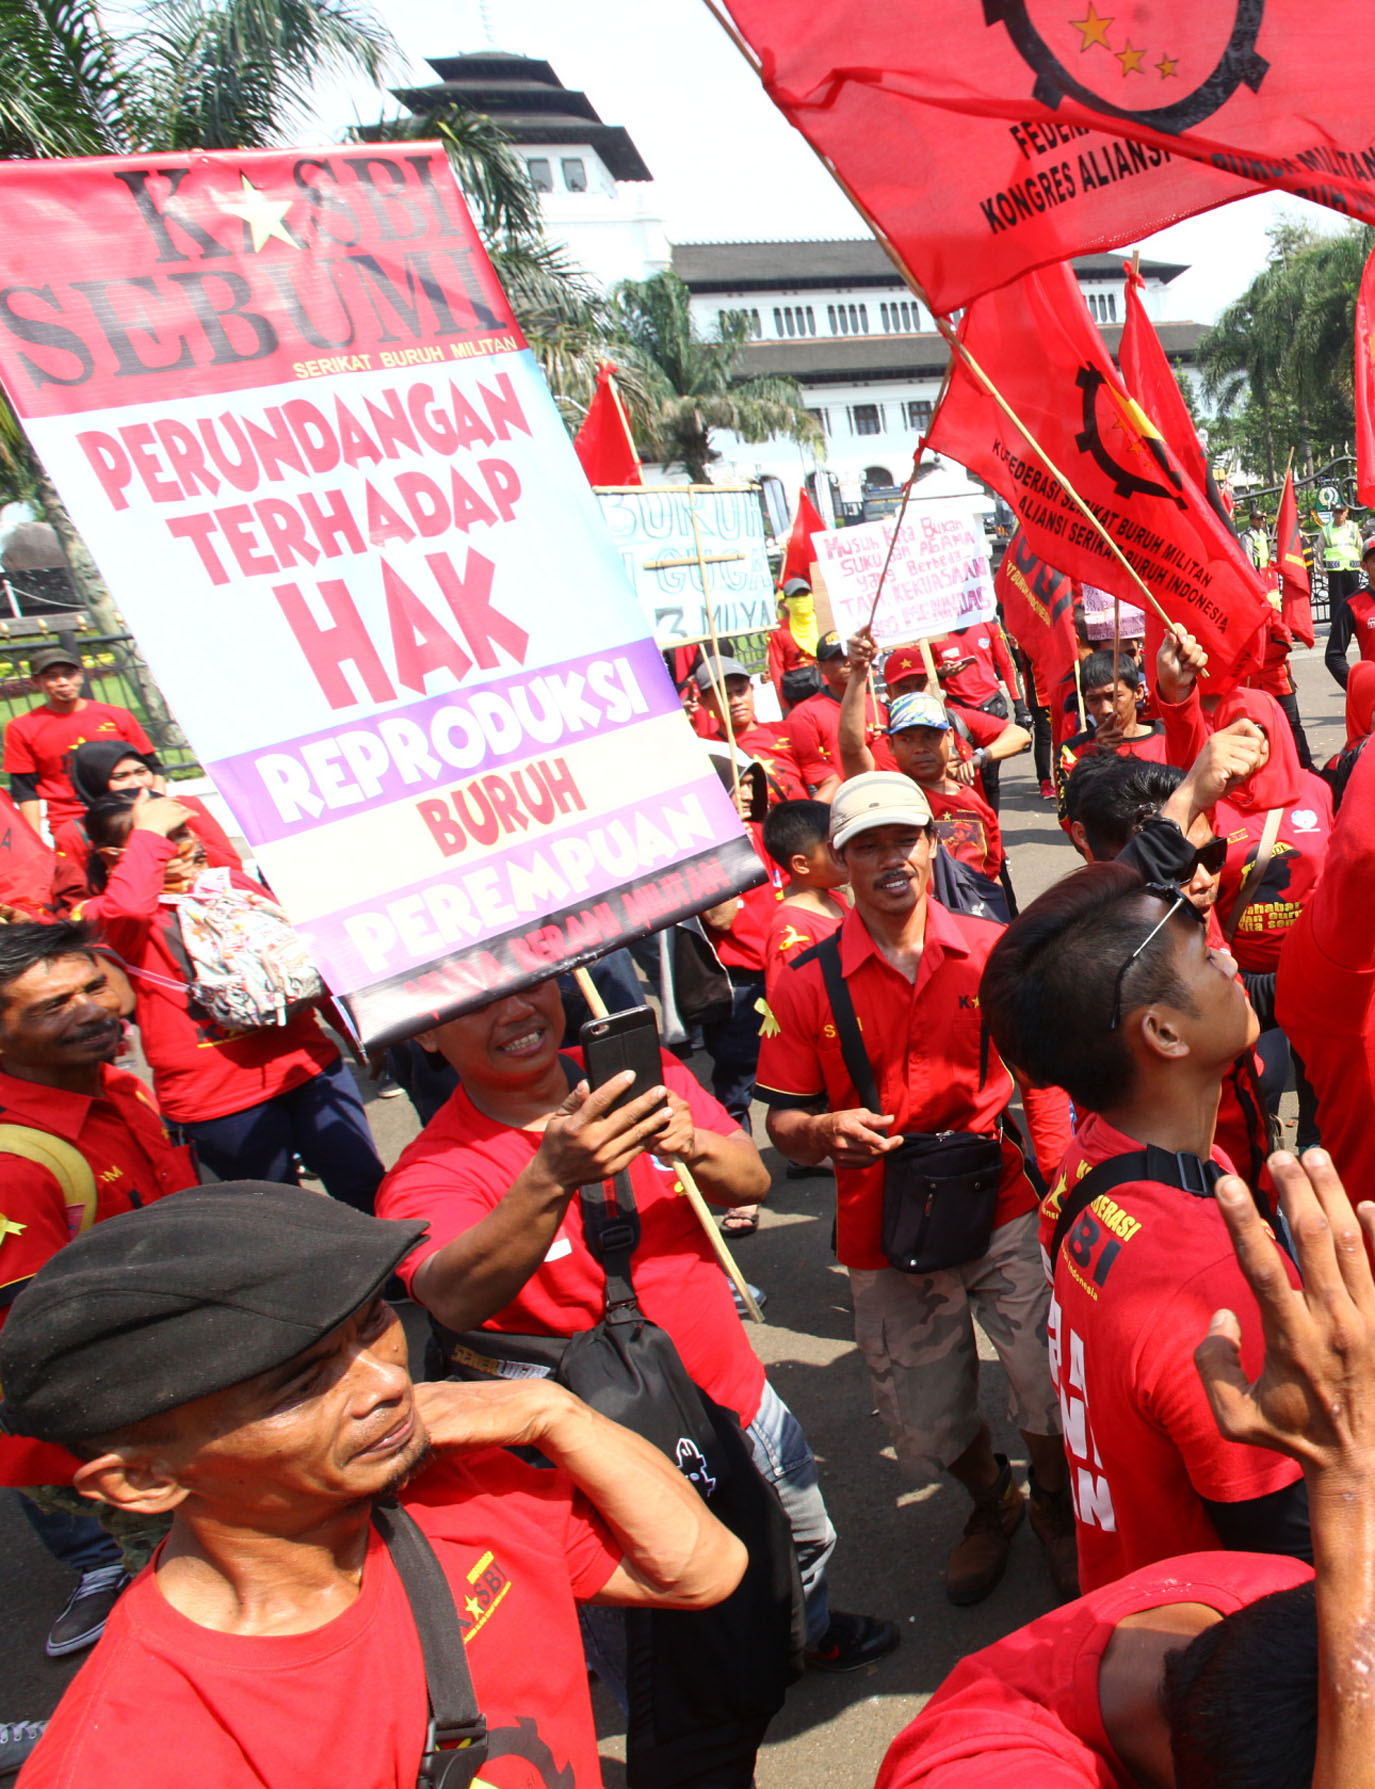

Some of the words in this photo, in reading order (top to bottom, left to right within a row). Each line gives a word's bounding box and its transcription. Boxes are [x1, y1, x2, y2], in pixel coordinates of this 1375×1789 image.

[979, 161, 1076, 234] KONGRES
[0, 247, 506, 388] SEBUMI
[292, 354, 371, 379] SERIKAT
[382, 346, 444, 367] BURUH
[451, 336, 517, 359] MILITAN
[75, 372, 533, 511] PERUNDANGAN
[165, 458, 522, 585] TERHADAP
[1018, 495, 1068, 538] ALIANSI
[1166, 574, 1230, 633] INDONESIA
[1116, 518, 1166, 554] BURUH
[1161, 544, 1213, 588] MILITAN
[272, 545, 530, 710] HAK
[254, 657, 649, 824] REPRODUKSI
[415, 757, 587, 858] BURUH
[343, 795, 716, 974] PEREMPUAN
